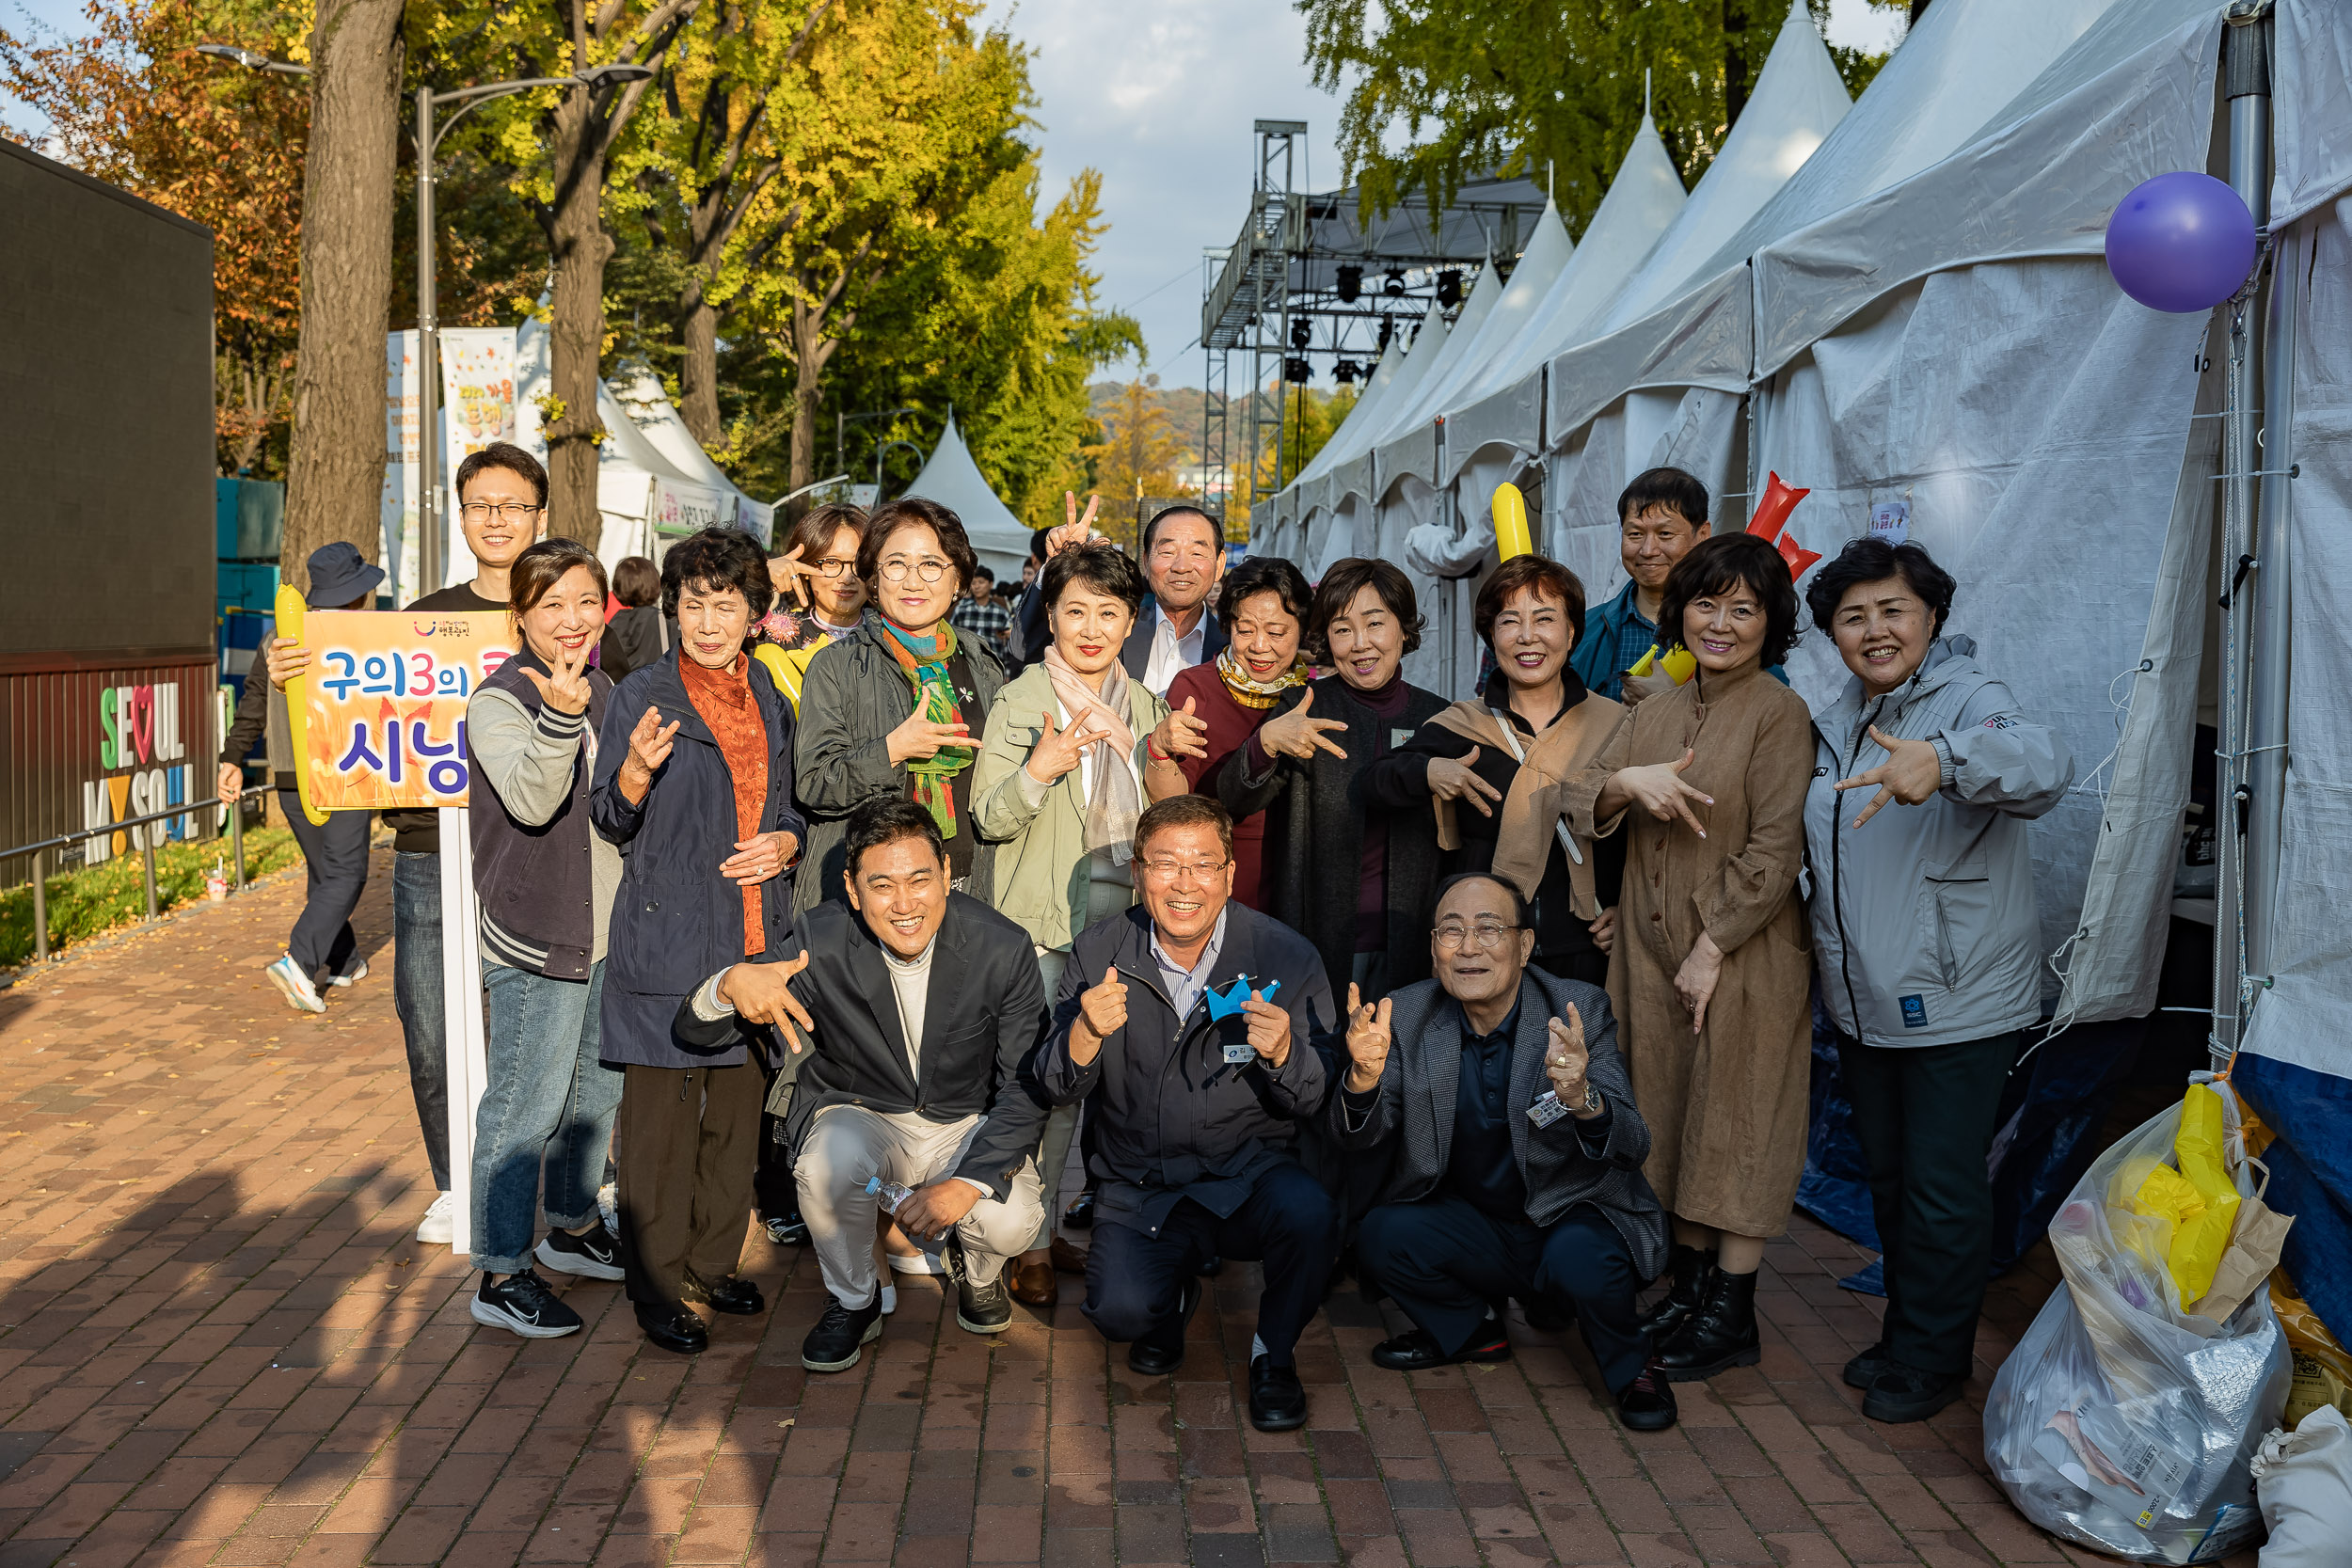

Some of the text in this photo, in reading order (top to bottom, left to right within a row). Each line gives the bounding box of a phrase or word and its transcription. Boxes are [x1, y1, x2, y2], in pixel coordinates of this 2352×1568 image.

[438, 626, 469, 637] 행복광진
[324, 652, 468, 700] 구의3의
[132, 763, 199, 851] SOUL
